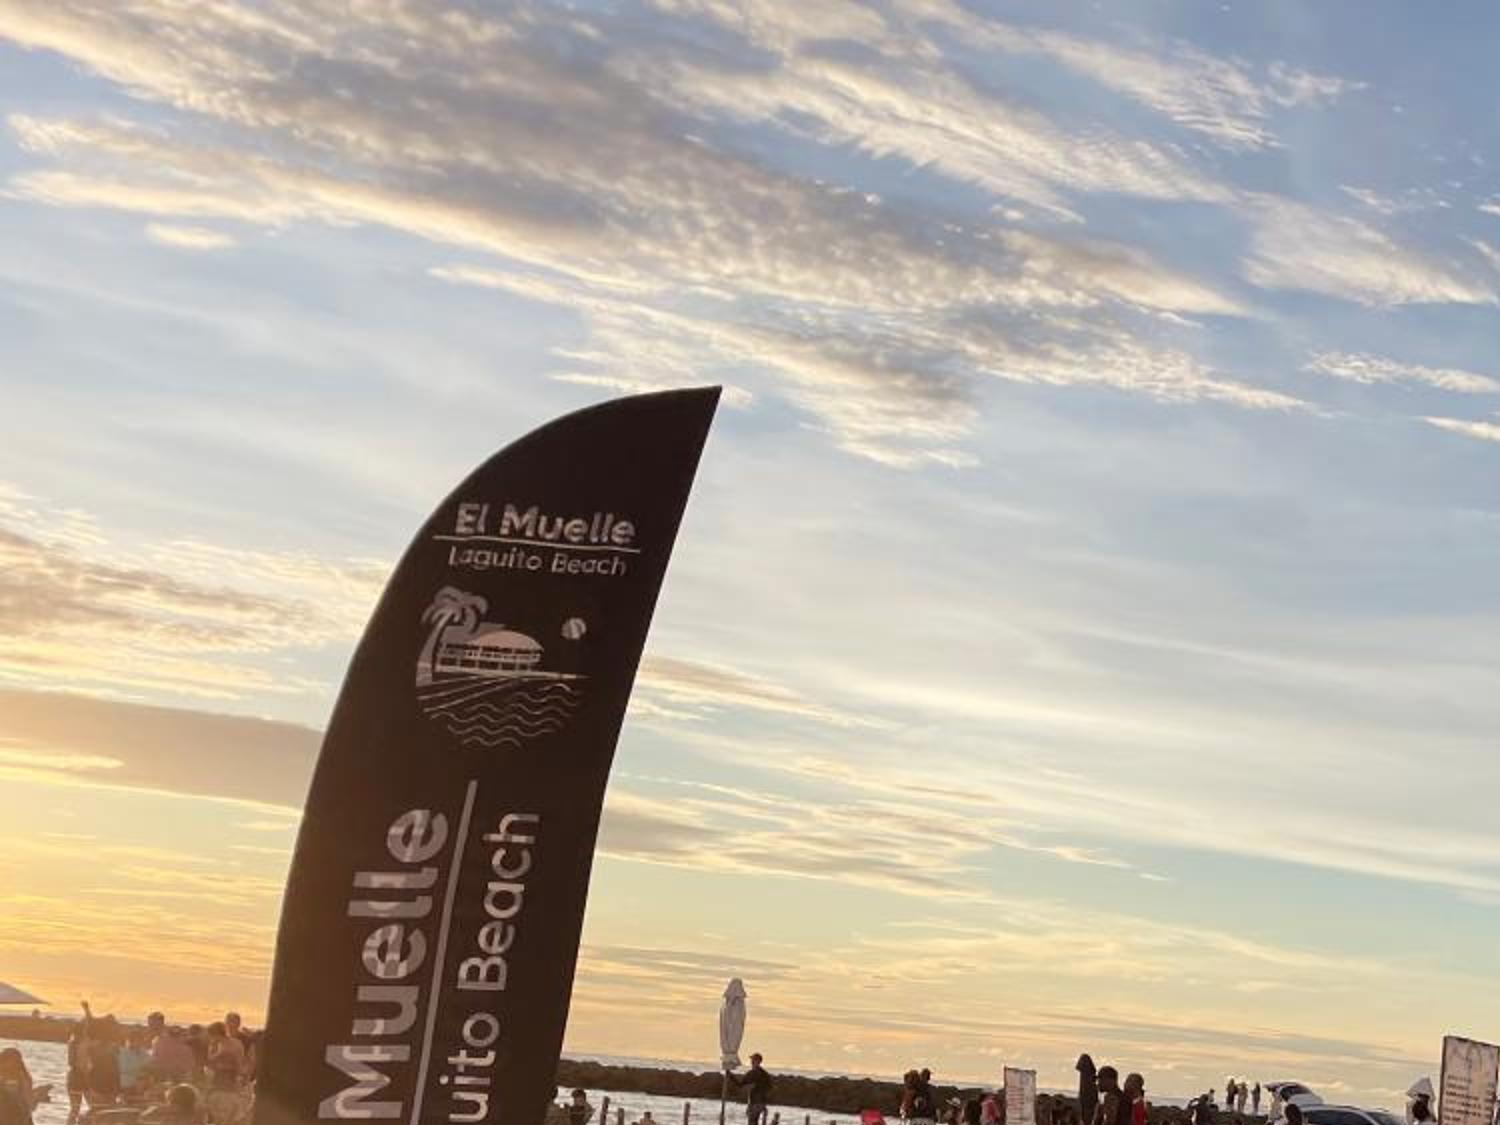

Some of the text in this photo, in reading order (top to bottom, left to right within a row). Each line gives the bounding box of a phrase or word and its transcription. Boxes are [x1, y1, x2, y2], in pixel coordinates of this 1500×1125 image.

[449, 545, 627, 576] Laguito Beach
[455, 503, 636, 545] El Muelle
[457, 812, 540, 991] Beach
[317, 808, 448, 1119] Muelle
